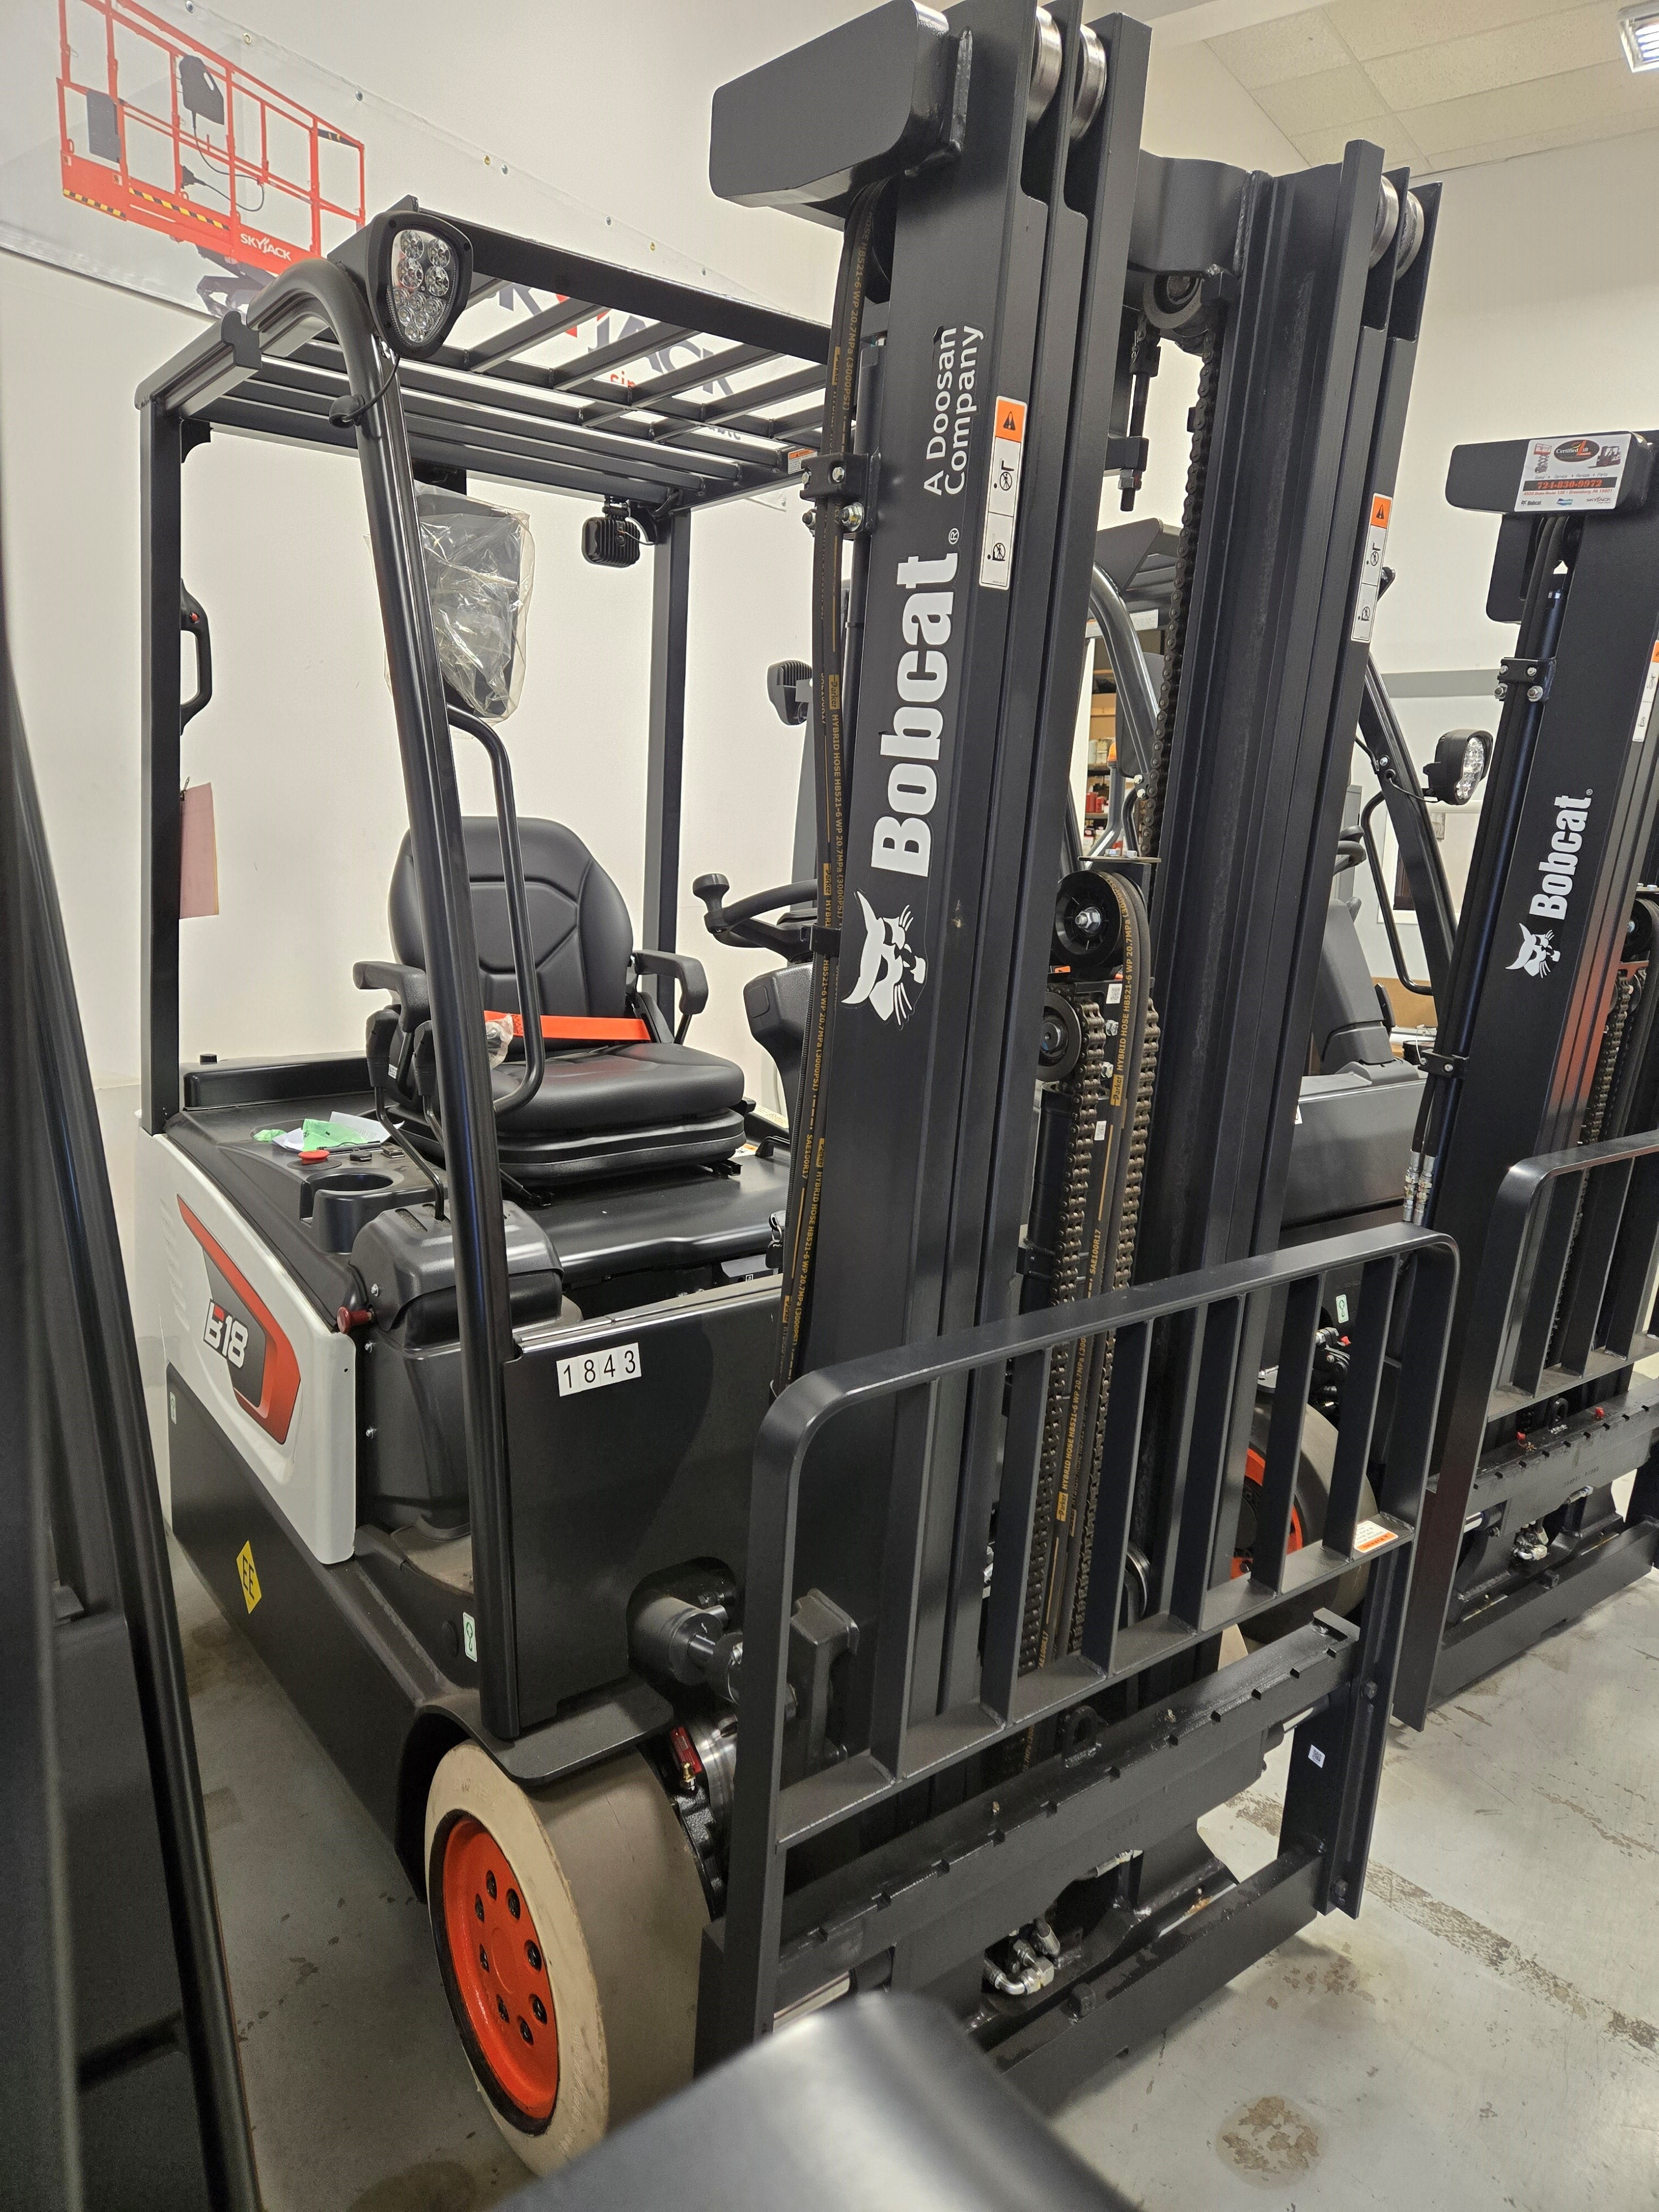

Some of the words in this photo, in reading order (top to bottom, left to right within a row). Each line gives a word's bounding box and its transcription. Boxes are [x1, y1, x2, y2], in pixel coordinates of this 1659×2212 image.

[239, 233, 292, 262] SKYJACK
[853, 291, 861, 309] WP
[847, 309, 859, 354] 20.7MPa
[842, 357, 854, 410] (3000PSI)
[926, 327, 957, 460] Doosan
[944, 325, 986, 495] Company
[924, 474, 943, 496] A
[1537, 479, 1602, 489] 724-830-9972
[836, 818, 843, 833] WP
[1125, 920, 1133, 957] 20.7MPa
[1126, 958, 1133, 973] WP
[821, 998, 827, 1011] WP
[1123, 974, 1132, 1012] HB521-6
[817, 1013, 826, 1048] 20.7MPa
[1120, 1014, 1129, 1037] HOSE
[812, 1048, 822, 1091] (3000PSI)
[1117, 1039, 1126, 1071] HYBRID
[1113, 1077, 1121, 1101] Parker
[802, 1134, 813, 1180] SAE100R17
[813, 1171, 823, 1202] HYBRID
[809, 1204, 818, 1225] HOSE
[804, 1226, 815, 1259] HB521-6
[1089, 1229, 1101, 1275] SAE100R17
[802, 1261, 809, 1273] WP
[797, 1274, 807, 1306] 20.7MPa
[563, 1350, 637, 1389] 1843
[1074, 1358, 1084, 1390] 20.7MPa
[1073, 1391, 1079, 1404] WP
[1068, 1405, 1078, 1438] HB521-6
[1066, 1438, 1074, 1459] HOSE
[1062, 1460, 1071, 1490] HYBRID
[242, 1554, 256, 1600] EE
